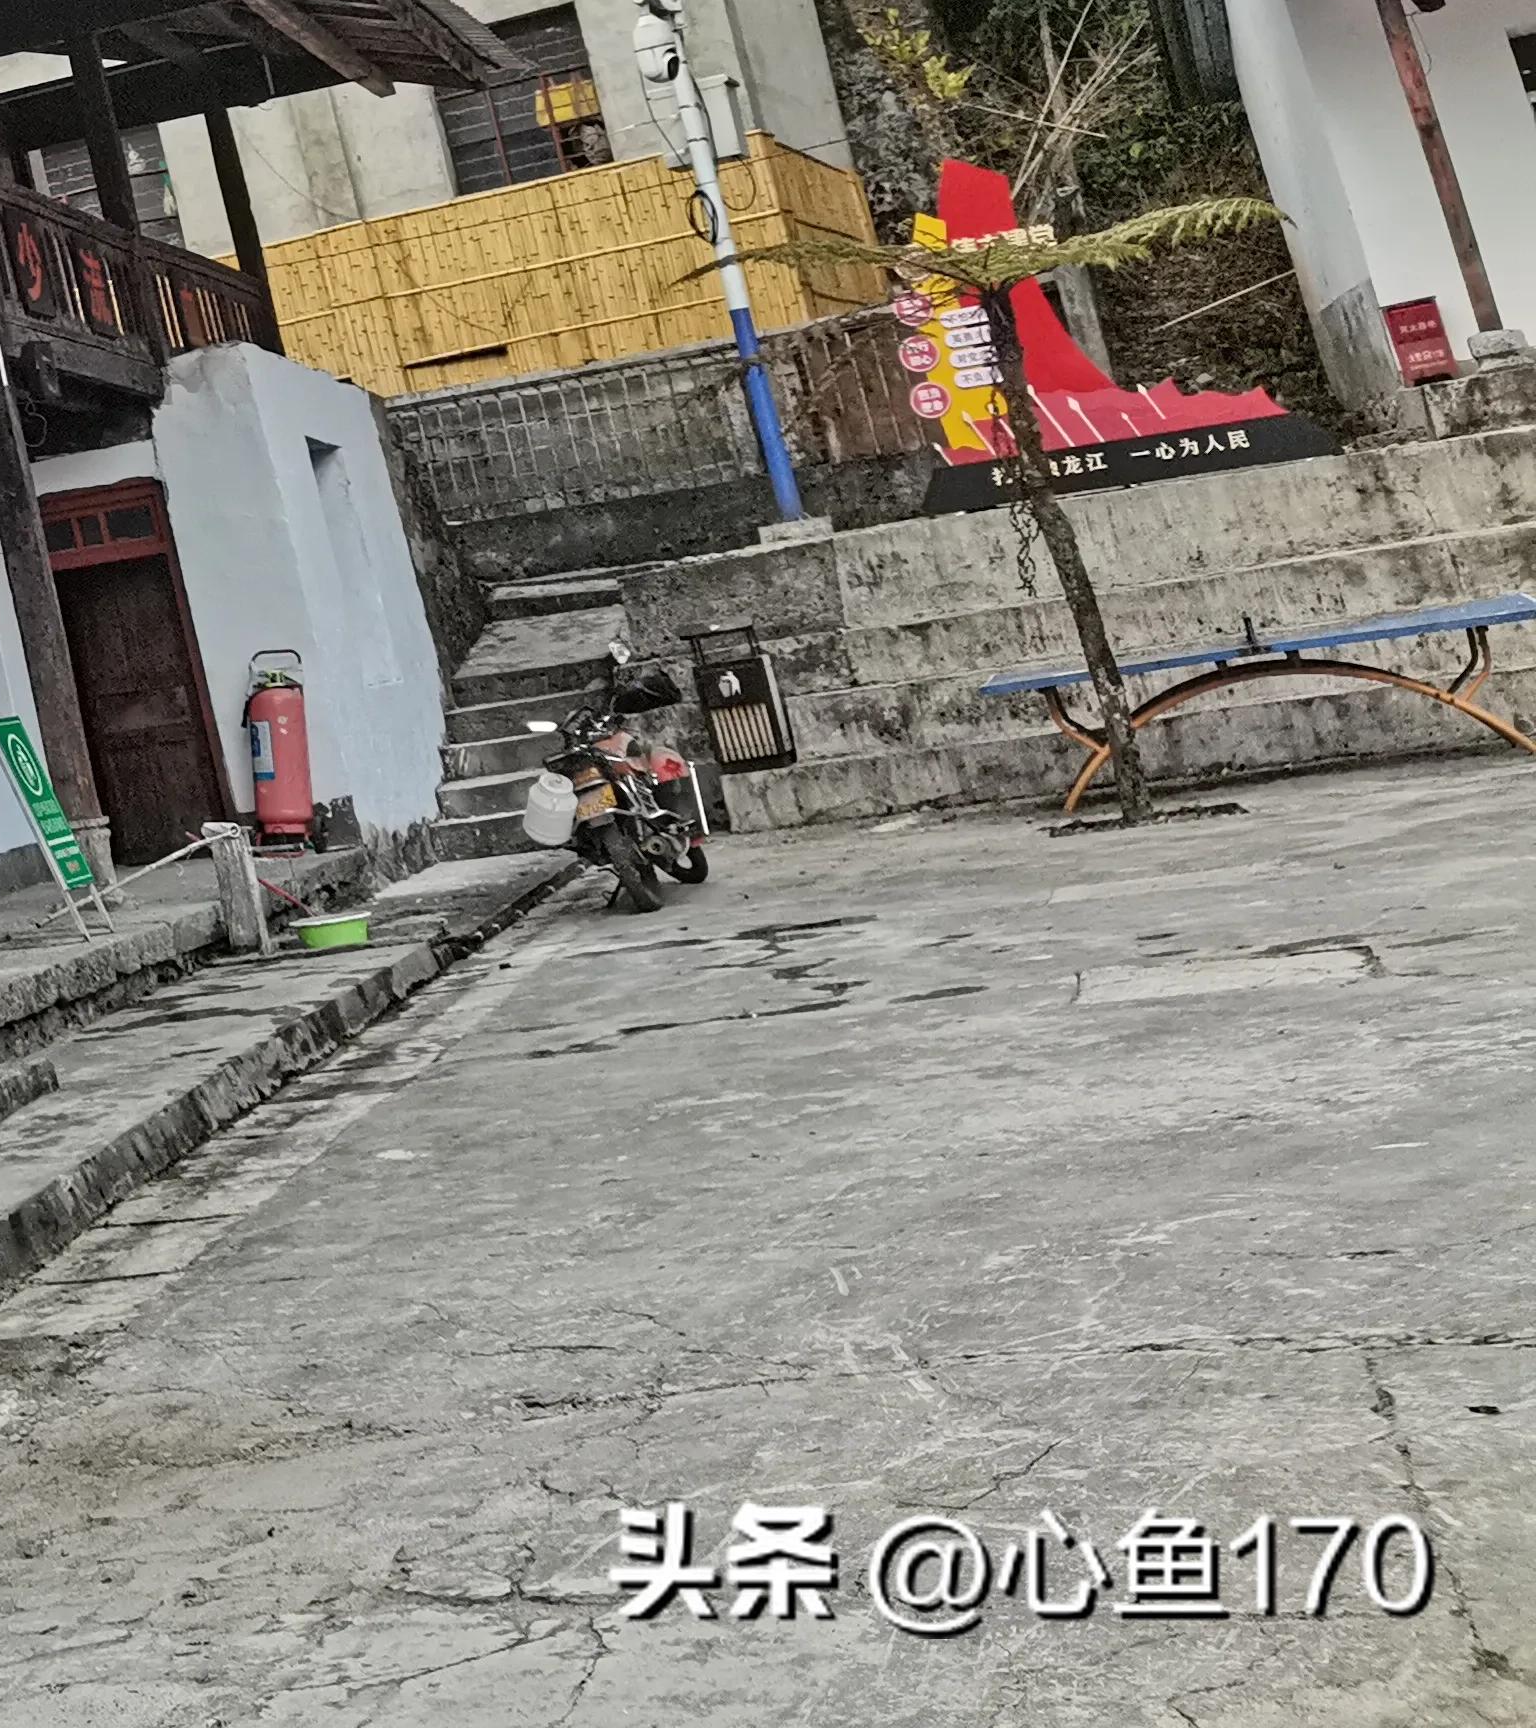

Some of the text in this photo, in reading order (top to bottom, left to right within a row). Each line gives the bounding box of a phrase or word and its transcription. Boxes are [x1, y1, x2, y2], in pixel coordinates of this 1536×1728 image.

[17, 223, 43, 302] 少
[1130, 429, 1252, 461] 一心为人民
